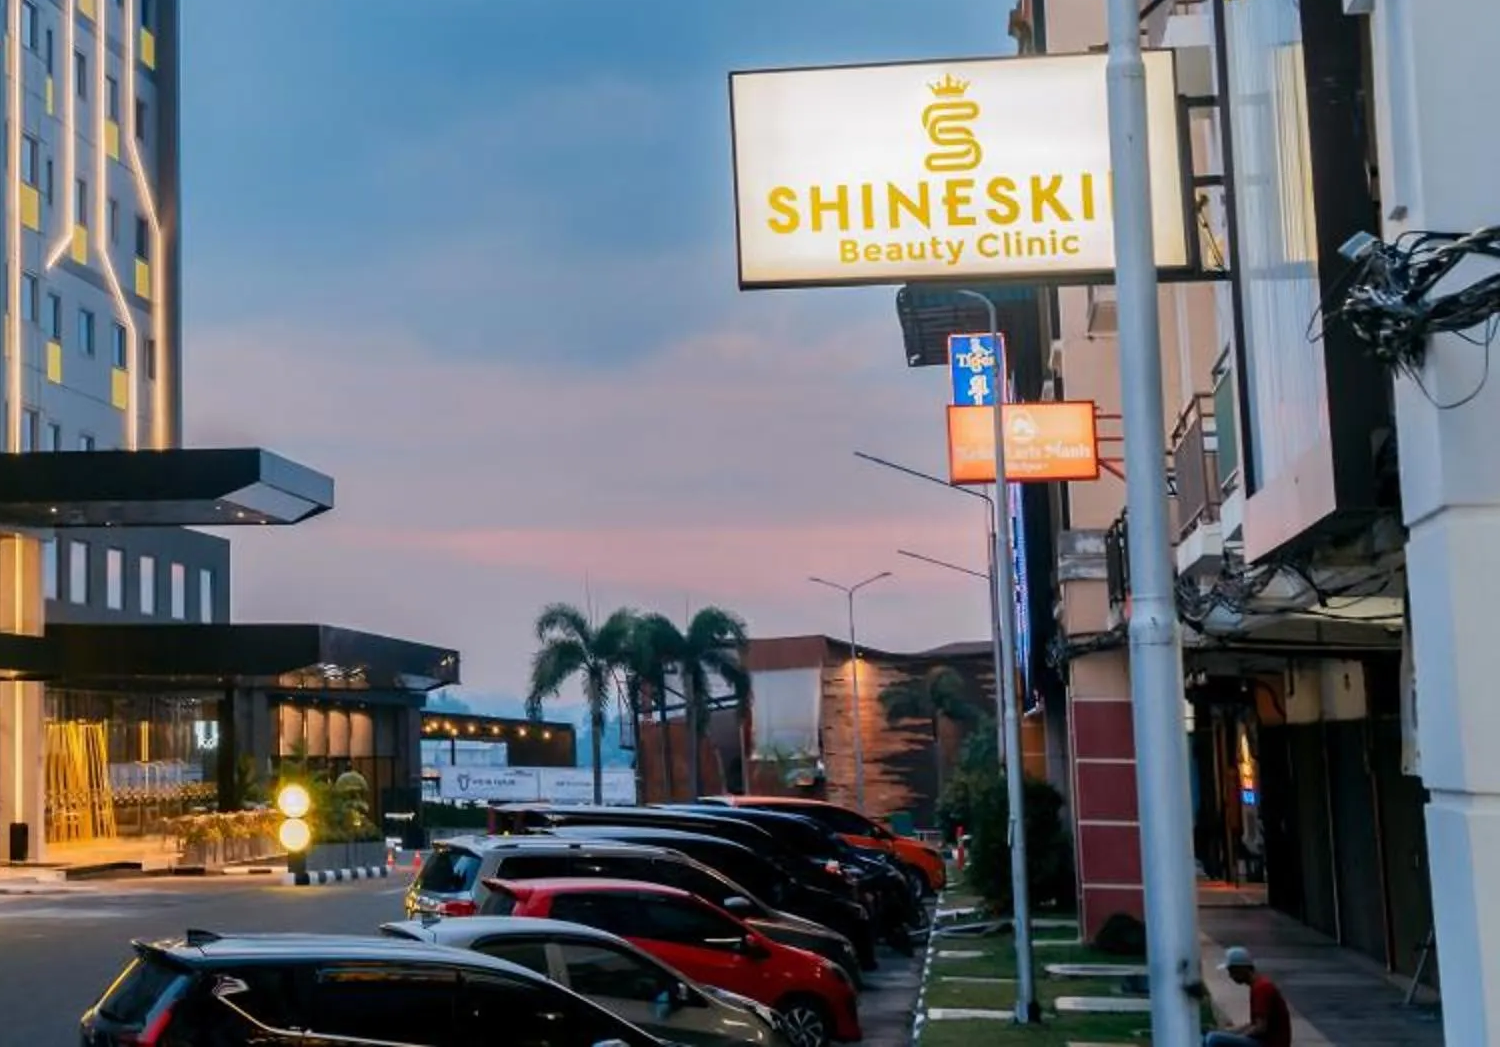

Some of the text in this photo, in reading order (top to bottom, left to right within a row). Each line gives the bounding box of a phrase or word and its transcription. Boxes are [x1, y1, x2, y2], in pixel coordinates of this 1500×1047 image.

[767, 172, 1114, 234] SHINESKI
[839, 229, 1080, 265] Beauty Clinic
